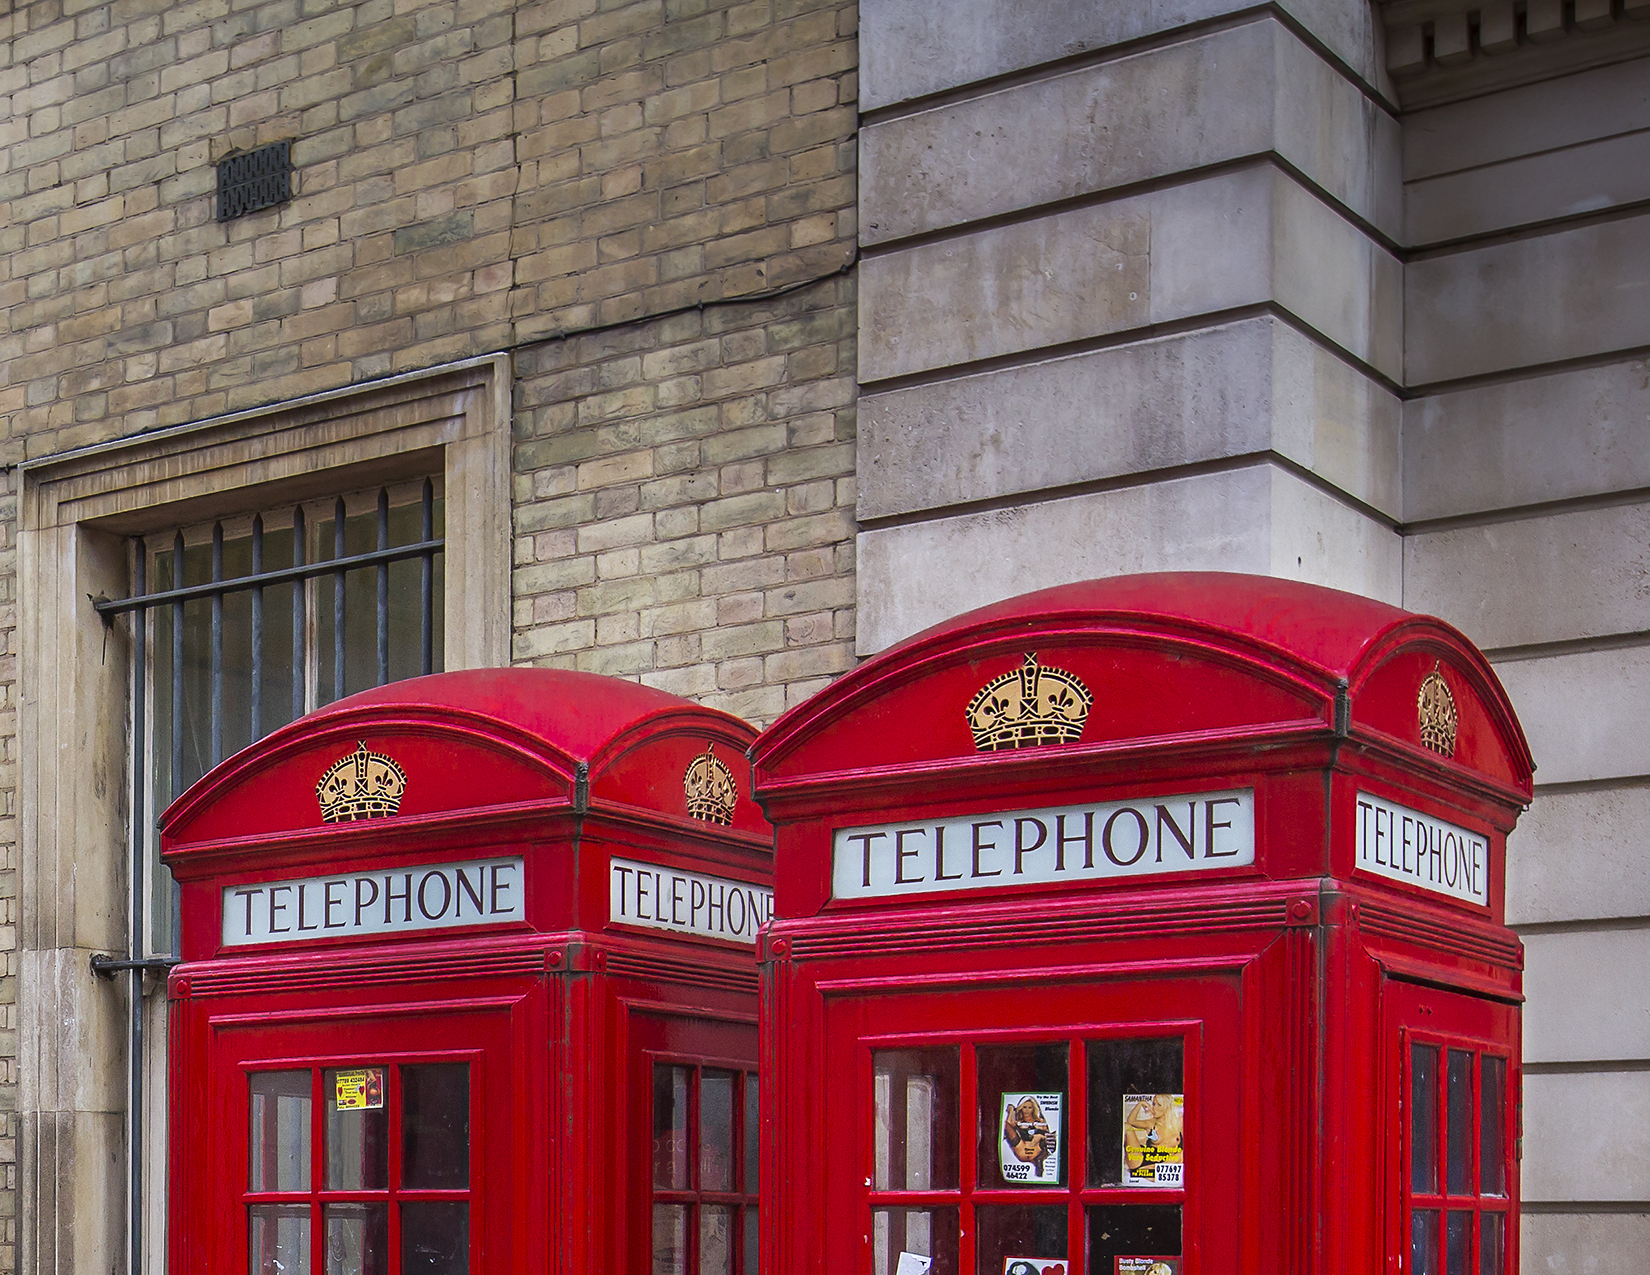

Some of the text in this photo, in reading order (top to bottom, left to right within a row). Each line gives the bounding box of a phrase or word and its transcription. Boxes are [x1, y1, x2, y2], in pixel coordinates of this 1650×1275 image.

[847, 797, 1242, 888] TELEPHONE
[1358, 800, 1483, 895] TELEPHONE
[234, 863, 517, 936] TELEPHONE
[1125, 1095, 1152, 1103] SAMANTHA
[1126, 1145, 1155, 1153] Genuine
[1145, 1153, 1179, 1161] Seductive
[1003, 1164, 1031, 1172] 074599
[1156, 1165, 1182, 1173] 077697
[1006, 1172, 1027, 1180] 46422
[1158, 1173, 1179, 1181] 85378
